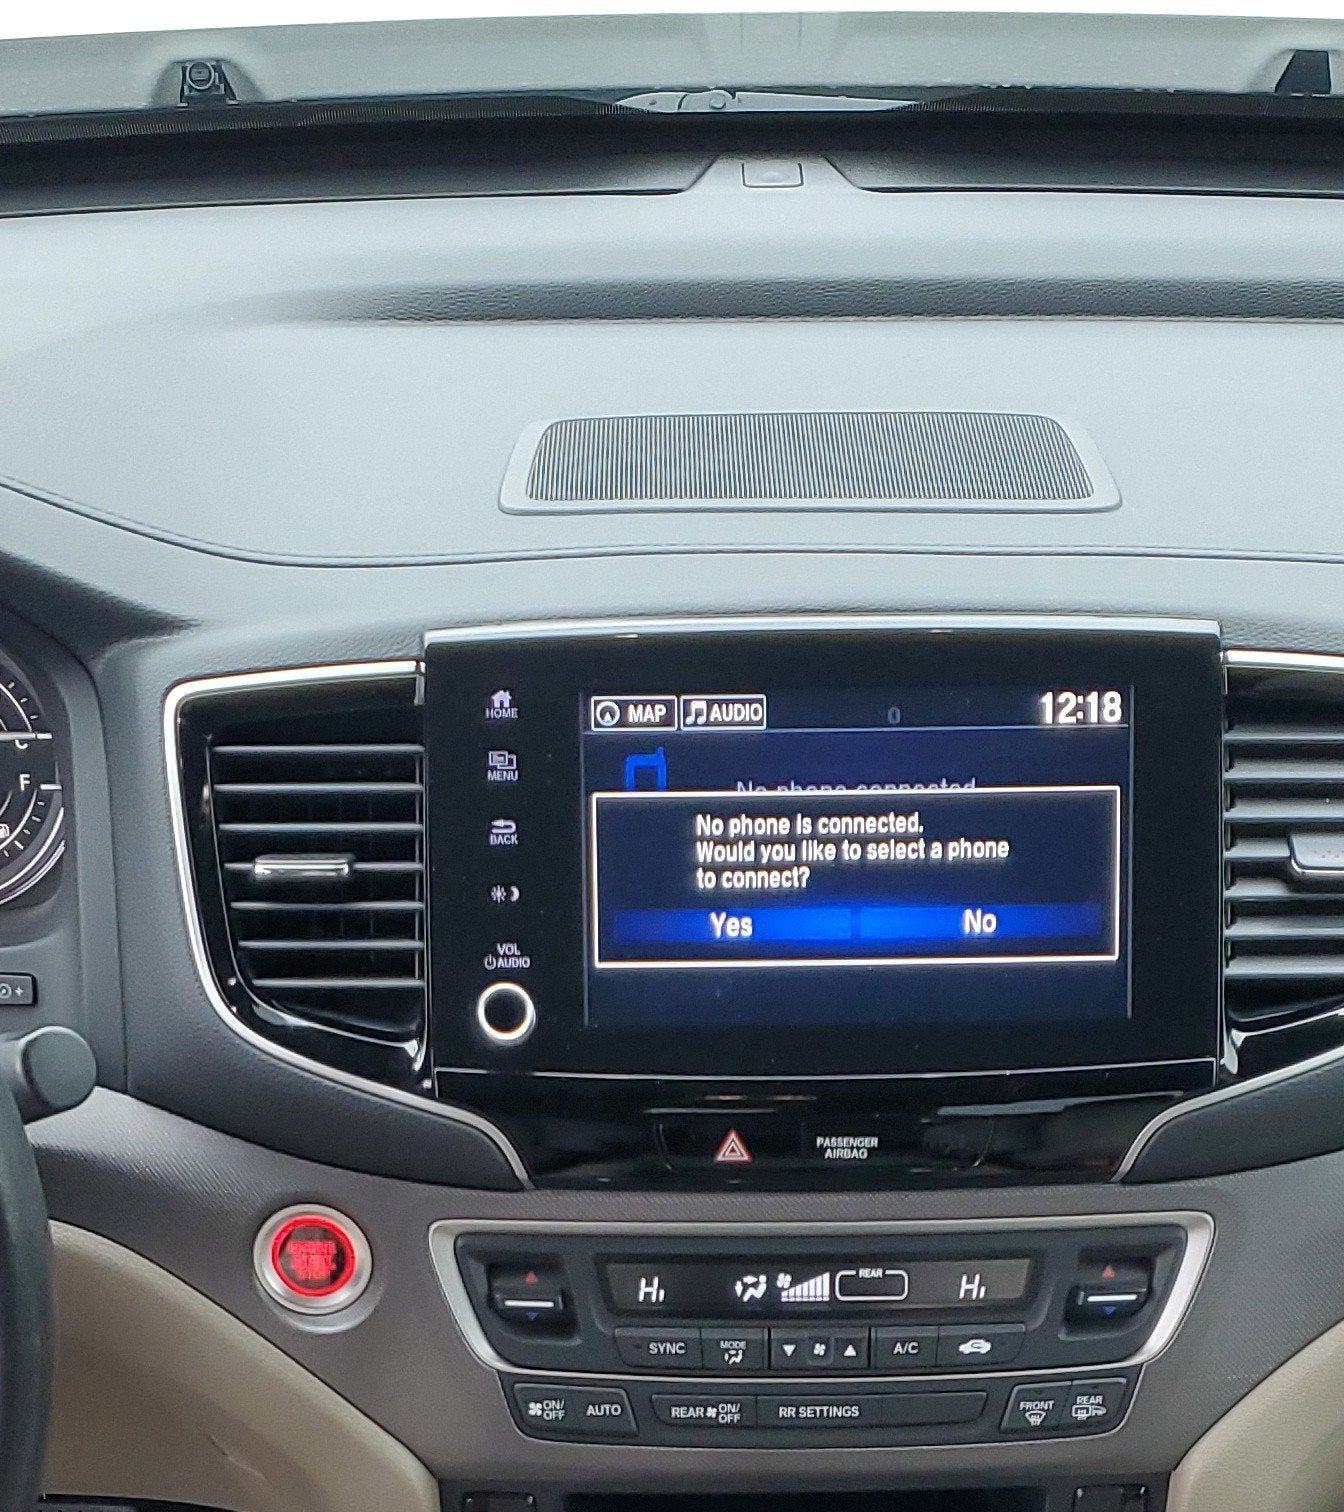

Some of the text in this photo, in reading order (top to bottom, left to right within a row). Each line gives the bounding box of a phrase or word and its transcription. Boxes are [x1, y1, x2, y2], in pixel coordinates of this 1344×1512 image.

[485, 707, 519, 720] HOME
[627, 703, 667, 723] MAP
[709, 702, 764, 723] AUDIO
[1040, 690, 1123, 724] 12:18
[19, 773, 32, 791] F
[487, 769, 519, 782] MENU
[695, 813, 725, 836] No
[729, 813, 791, 838] phone
[818, 811, 925, 834] connected.
[489, 834, 519, 846] BACK
[695, 837, 1011, 865] Would you like to select a phone
[695, 865, 812, 889] to connect?
[708, 911, 754, 939] Yes
[962, 907, 998, 935] No
[496, 942, 522, 956] VOL
[497, 956, 532, 969] AUDIO
[816, 1136, 879, 1149] PASSENGER
[824, 1147, 869, 1160] AIRBAG
[858, 1267, 884, 1279] REAR
[648, 1341, 686, 1355] SYNC
[719, 1340, 747, 1350] MODE
[892, 1341, 919, 1355] A/C
[542, 1399, 566, 1410] ON/
[1019, 1400, 1055, 1411] FRONT
[1076, 1395, 1104, 1405] REAR
[586, 1404, 622, 1417] AUTO
[670, 1406, 705, 1419] REAR
[718, 1402, 741, 1413] ON/
[778, 1405, 860, 1419] RR SETTINGS
[542, 1409, 566, 1421] OFF
[718, 1413, 741, 1424] OFF
